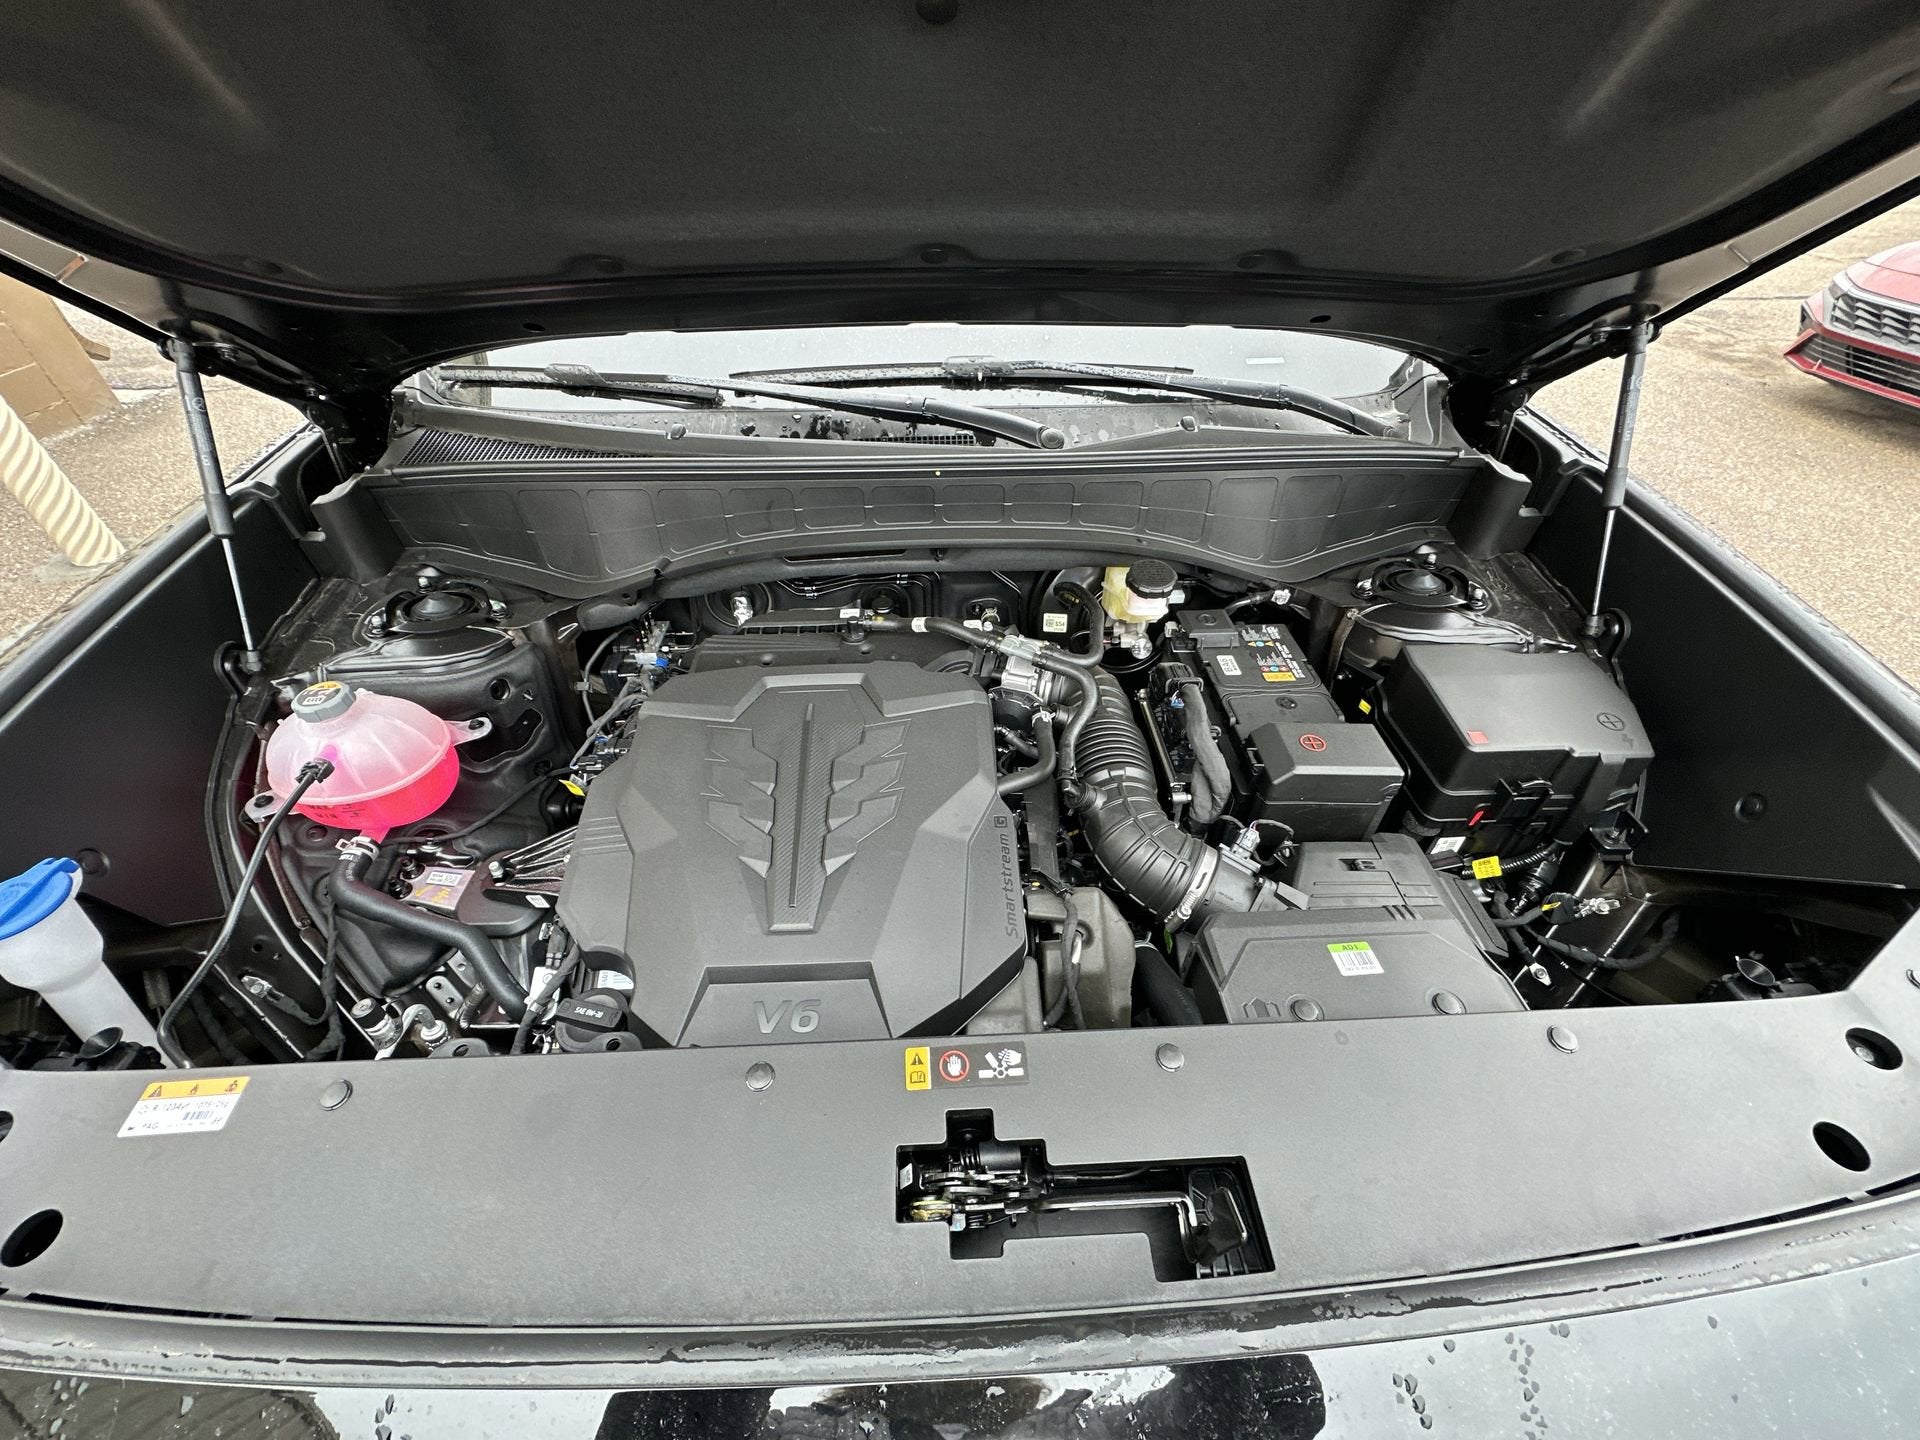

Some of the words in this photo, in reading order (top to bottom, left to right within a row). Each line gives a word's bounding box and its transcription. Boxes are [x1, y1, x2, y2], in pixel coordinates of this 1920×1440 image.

[1000, 833, 1019, 939] Smartstream
[574, 1005, 588, 1015] SAE
[754, 998, 821, 1035] V6
